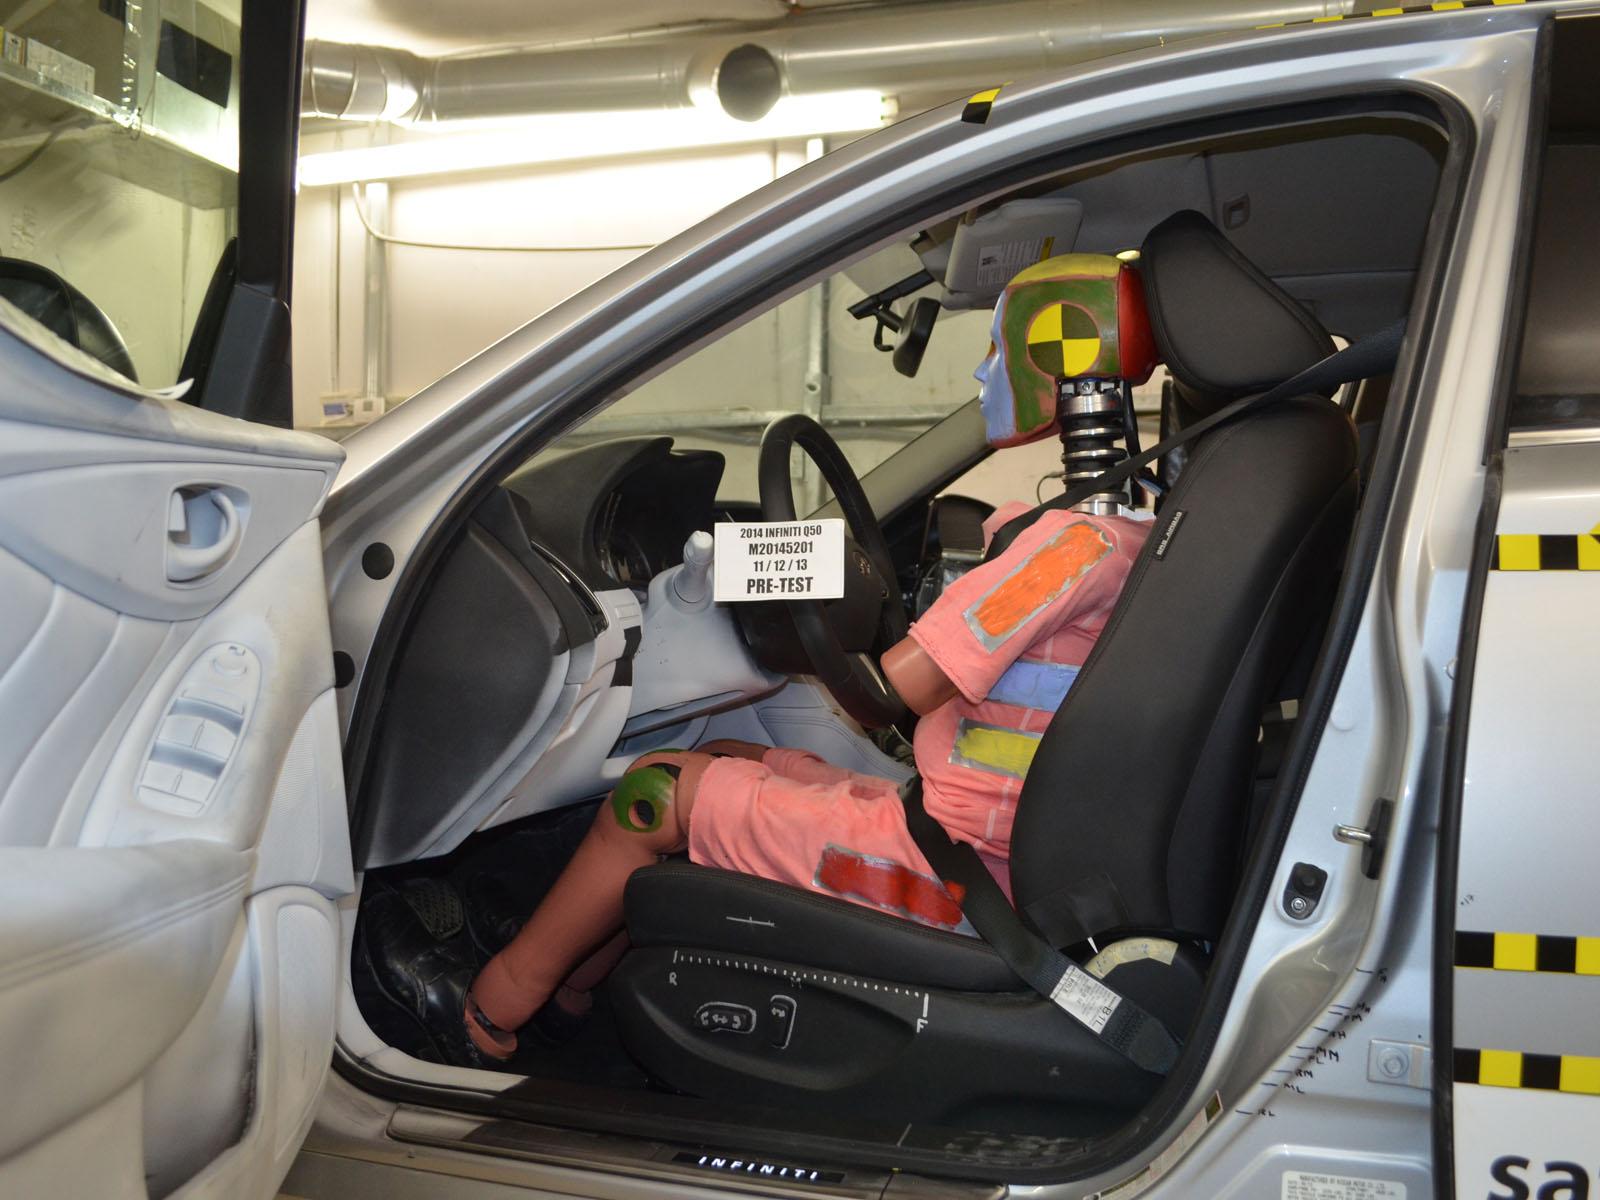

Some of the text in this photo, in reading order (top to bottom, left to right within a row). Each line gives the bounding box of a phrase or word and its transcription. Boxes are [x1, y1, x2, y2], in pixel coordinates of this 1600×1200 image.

[740, 525, 822, 539] 2014 INFINITI Q50
[749, 541, 814, 555] M20145201
[746, 577, 814, 594] PRE-TEST
[669, 972, 678, 986] R
[1295, 1068, 1314, 1078] RM
[698, 1156, 818, 1180] INFINITI
[1486, 1154, 1600, 1200] sa
